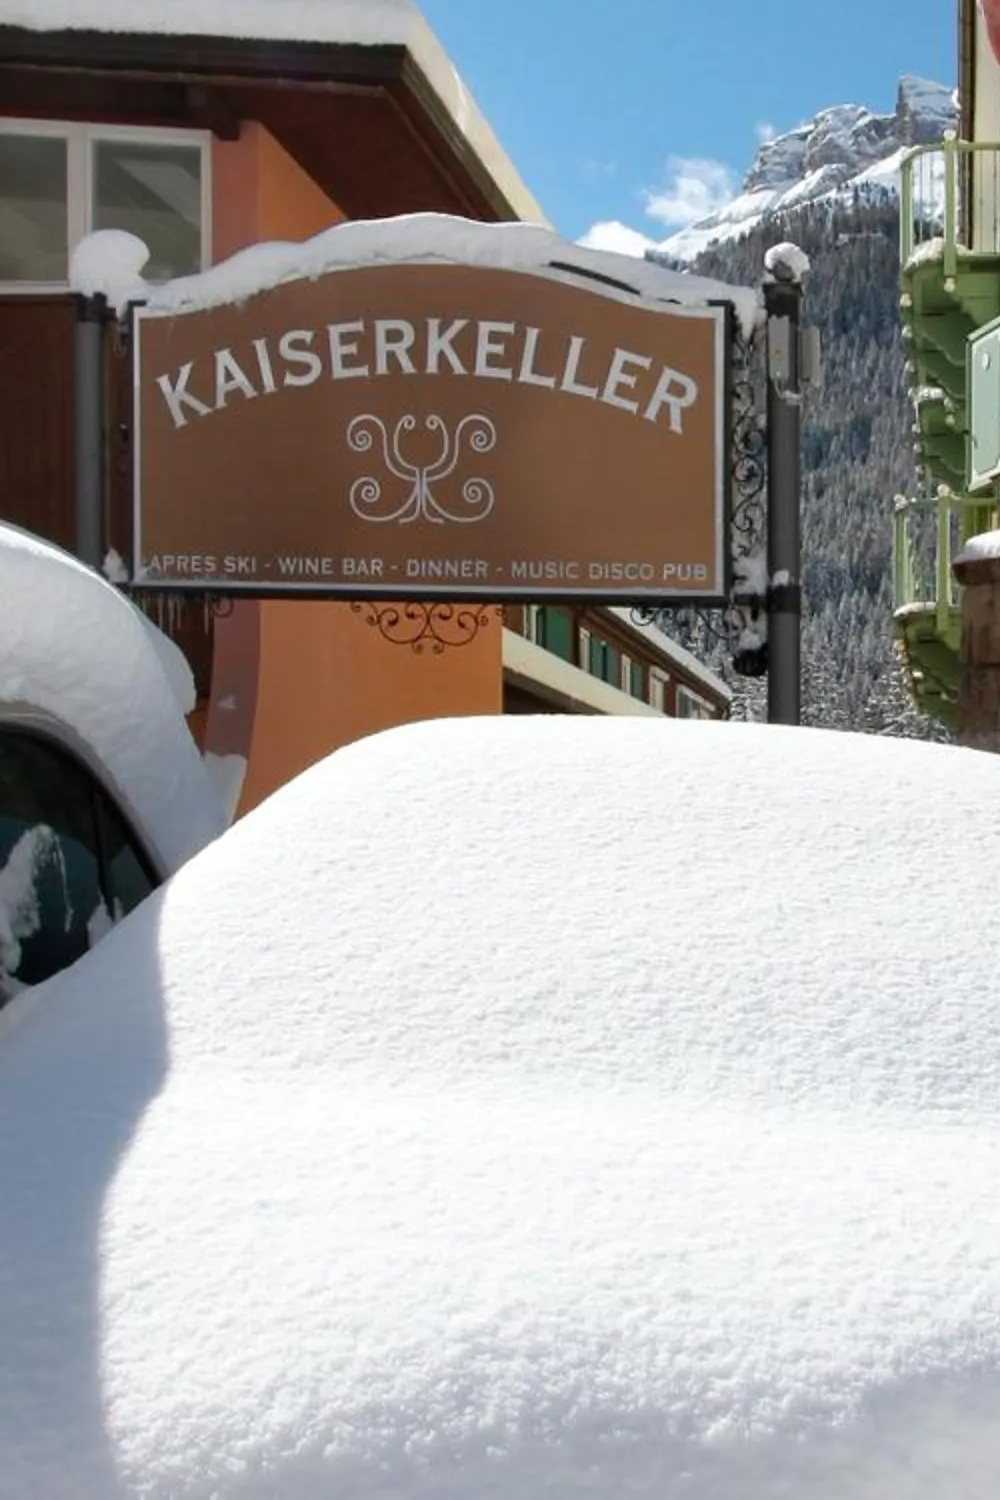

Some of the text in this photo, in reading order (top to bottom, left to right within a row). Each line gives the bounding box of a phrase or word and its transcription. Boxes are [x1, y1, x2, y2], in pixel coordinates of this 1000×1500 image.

[157, 318, 698, 433] KAISERKELLER
[149, 554, 216, 574] APRES
[222, 555, 258, 574] SKI
[278, 557, 333, 575] WINE
[342, 558, 385, 577] BAR
[405, 558, 489, 578] DINNER
[510, 560, 580, 580] MUSIC
[588, 562, 655, 582] DISCO
[662, 562, 708, 582] PUB
